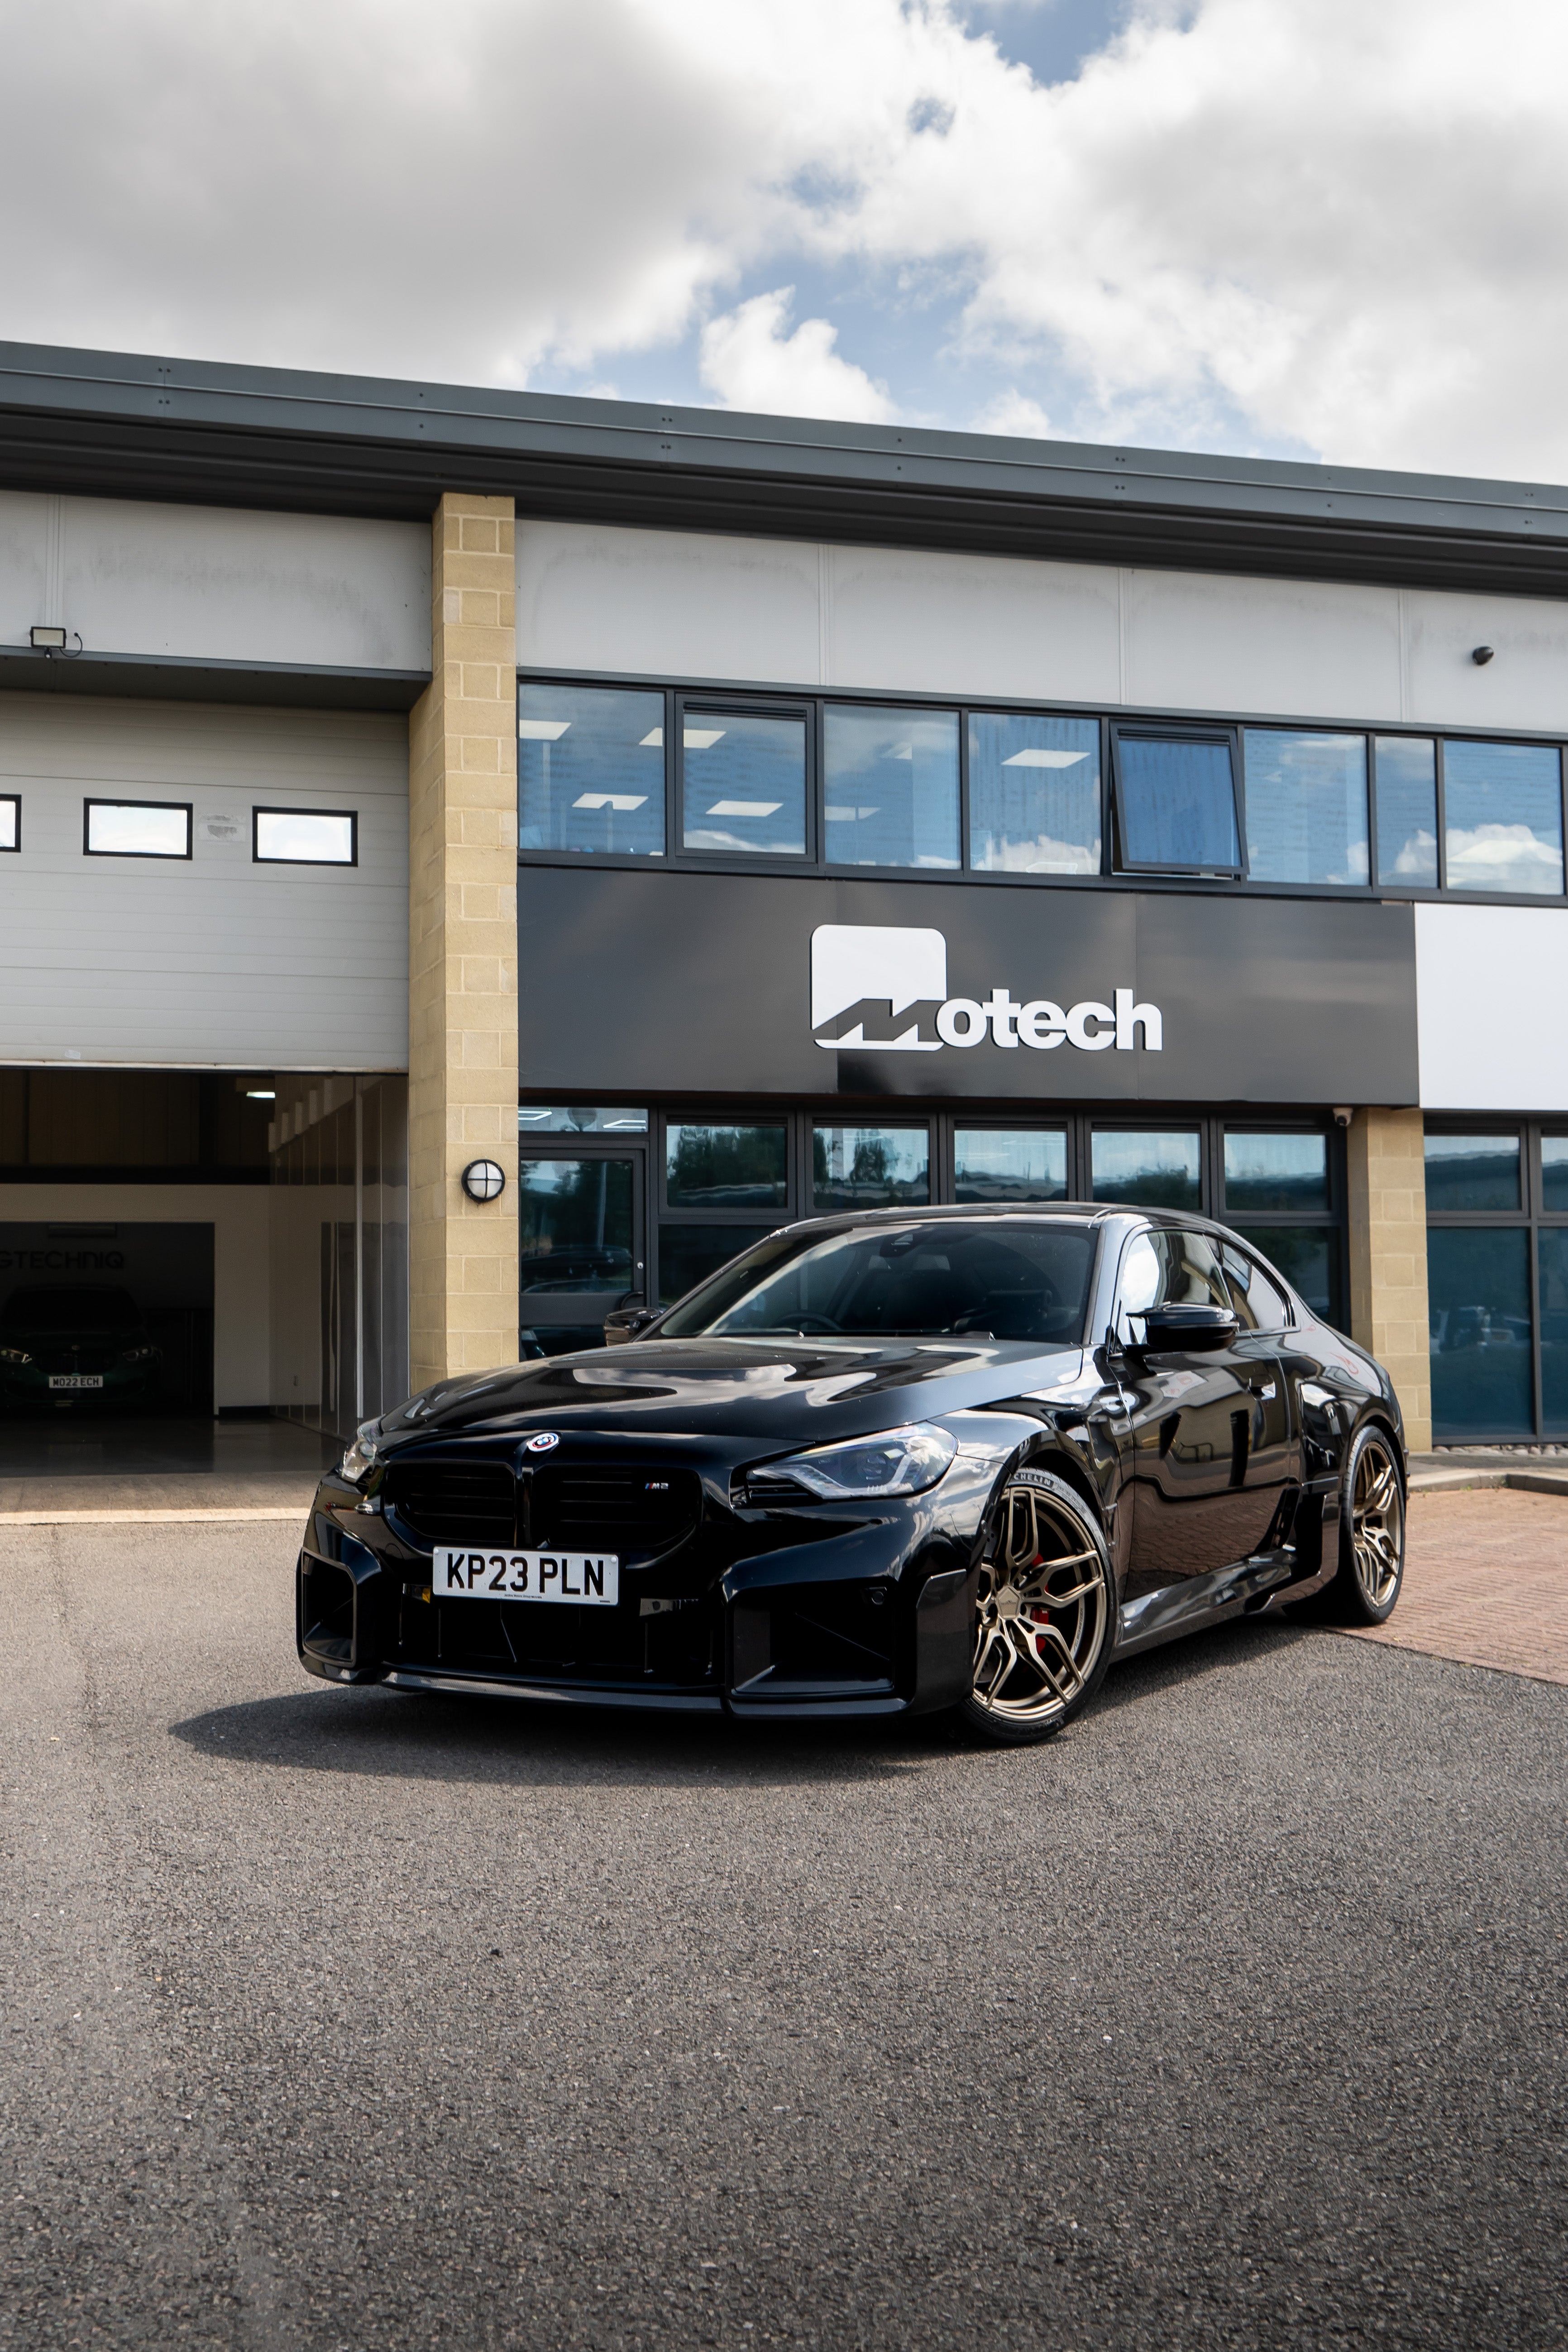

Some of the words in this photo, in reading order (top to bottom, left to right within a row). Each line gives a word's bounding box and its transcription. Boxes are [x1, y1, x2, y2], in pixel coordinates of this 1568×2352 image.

[812, 924, 1162, 1051] Motech
[80, 1377, 99, 1386] ECH
[1013, 1473, 1051, 1487] CHELIN
[447, 1553, 529, 1592] KP23
[540, 1557, 604, 1597] PLN
